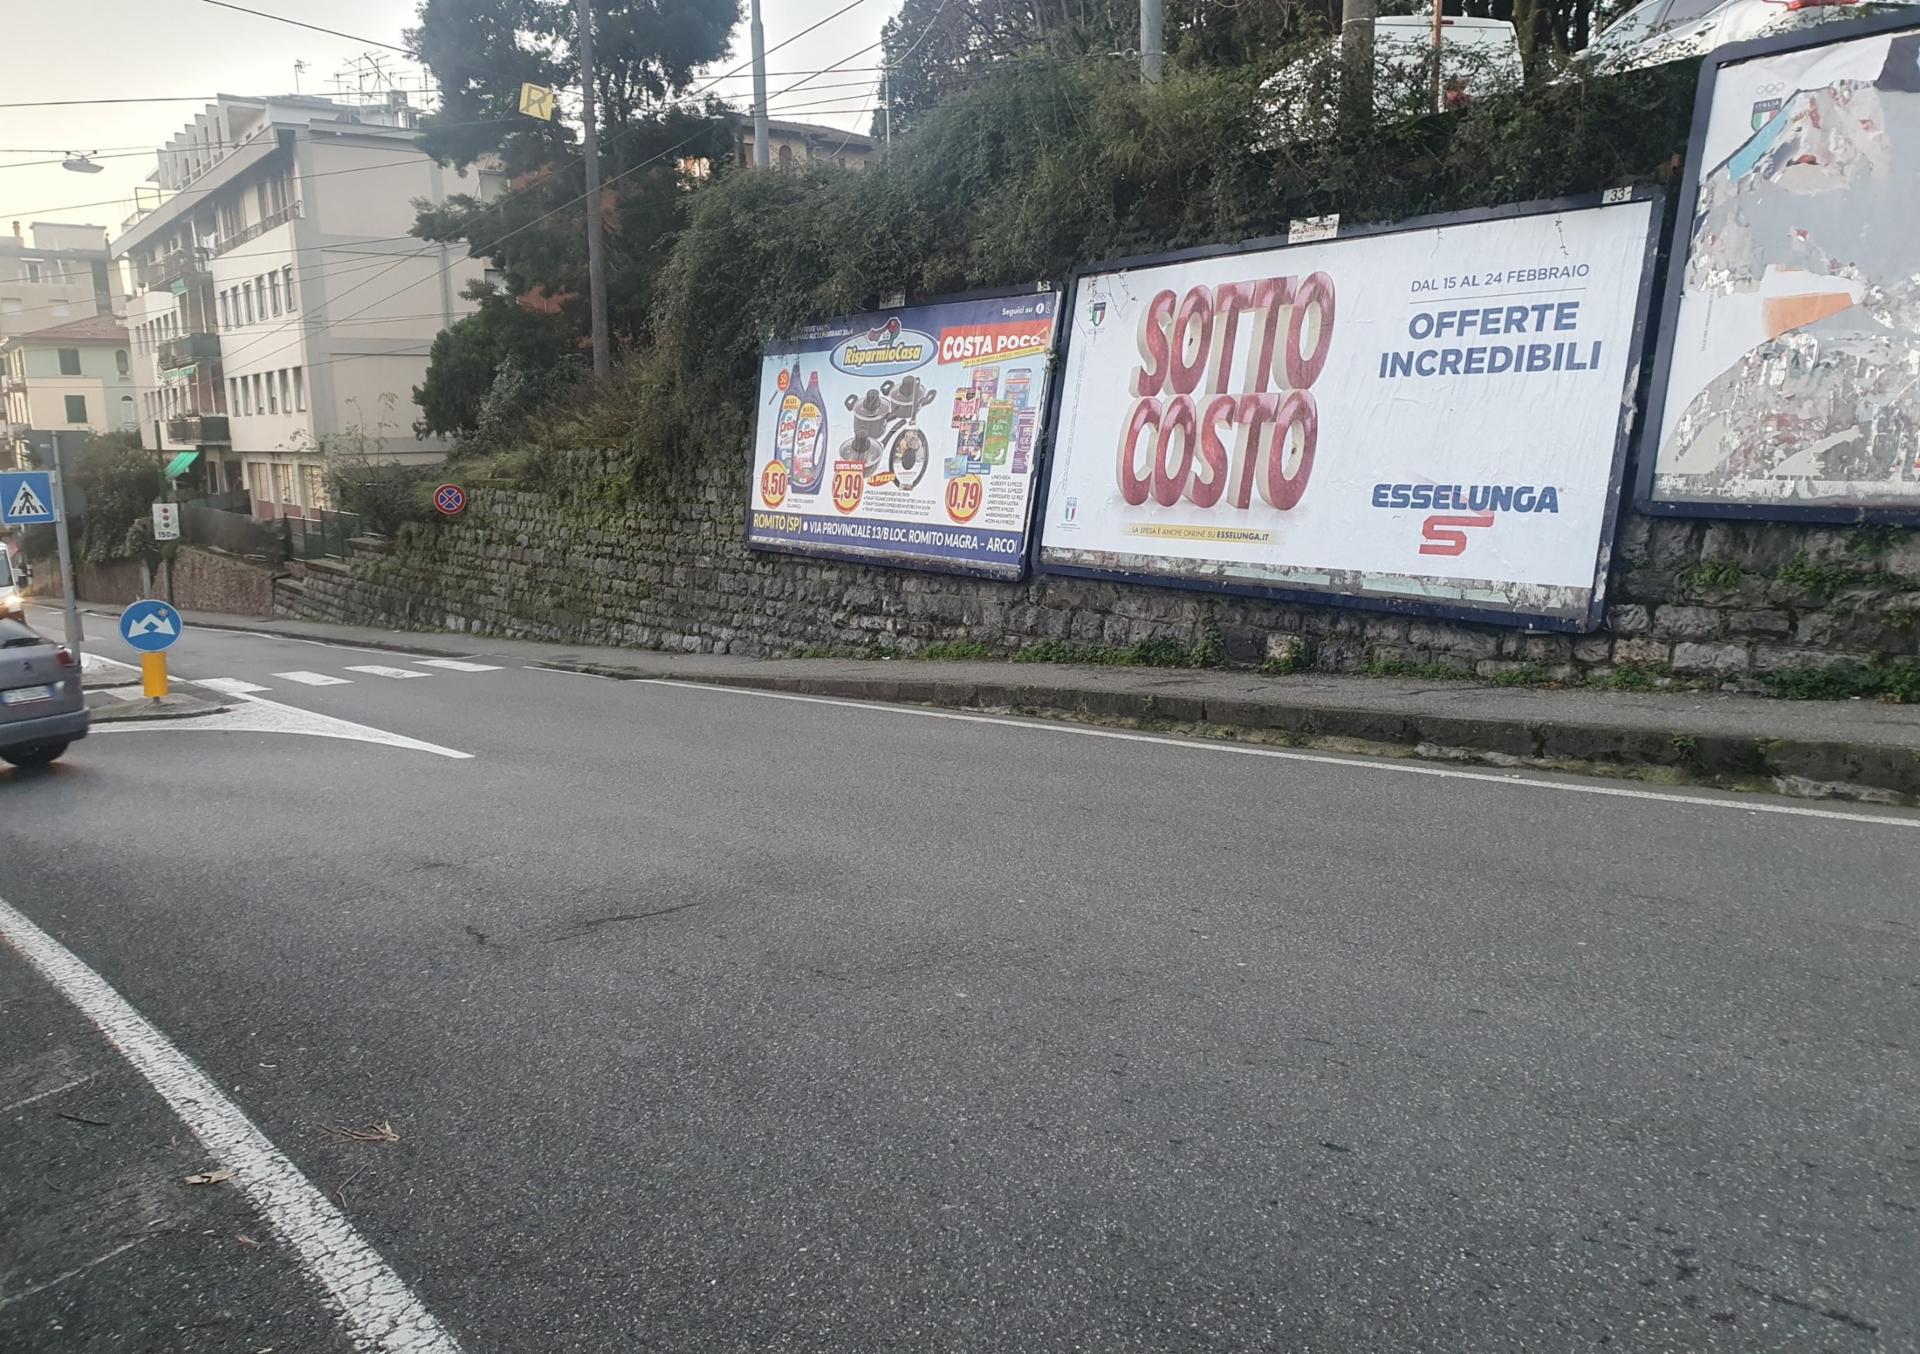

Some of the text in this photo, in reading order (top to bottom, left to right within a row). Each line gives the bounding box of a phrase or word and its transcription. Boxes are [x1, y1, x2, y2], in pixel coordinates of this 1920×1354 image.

[1410, 263, 1590, 292] DAL 15 AL 24 FEBBRAIO
[1002, 305, 1024, 316] Seguici
[1408, 301, 1580, 340] OFFERTE
[942, 335, 993, 360] COSTA
[996, 335, 1041, 352] POCO
[1129, 271, 1336, 398] SOTTO
[844, 344, 922, 366] RisparmioCasa
[1379, 341, 1602, 379] INCREDIBILI
[1116, 389, 1318, 511] COSTO
[762, 472, 786, 496] 4,50
[833, 474, 862, 500] 2,99
[949, 482, 980, 510] 0,79
[1371, 484, 1559, 513] ESSELUNGA
[753, 513, 786, 529] ROMITO
[786, 515, 802, 534] (SP)
[809, 521, 822, 534] VIA
[822, 522, 871, 538] PROVINCIALE
[872, 526, 889, 540] 13/B
[890, 528, 907, 542] LOC.
[908, 530, 944, 546] ROMITO
[944, 532, 978, 549] MAGRA
[1161, 528, 1182, 536] ANCHE
[1183, 529, 1207, 537] ONLINE
[1216, 531, 1269, 541] ESSELUNGA.IT
